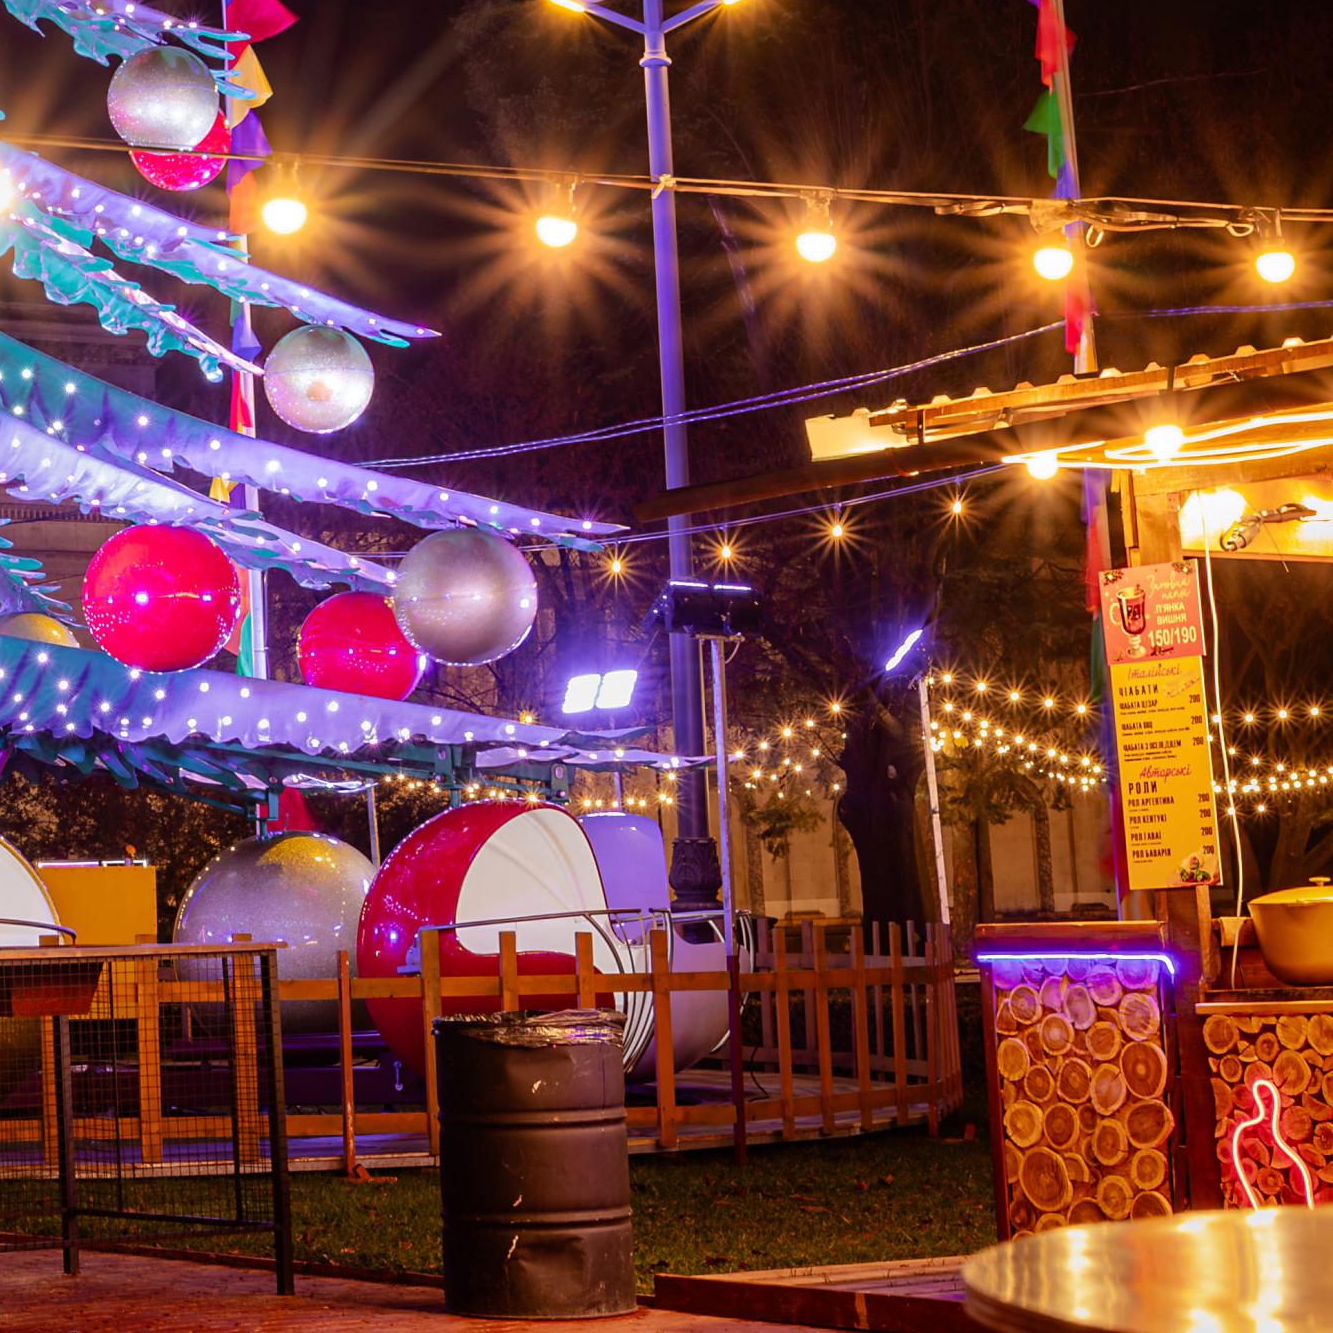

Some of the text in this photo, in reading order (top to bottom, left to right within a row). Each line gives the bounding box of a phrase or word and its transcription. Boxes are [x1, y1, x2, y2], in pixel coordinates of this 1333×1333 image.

[1157, 613, 1187, 625] ВИШНЯ
[1148, 626, 1197, 647] 150/190
[1119, 684, 1158, 697] ЧІАБАТИ
[1189, 694, 1201, 704] 200
[1191, 715, 1202, 725] 200
[1193, 736, 1204, 746] 200
[1140, 764, 1192, 783] Авторські
[1128, 781, 1157, 795] РОЛИ
[1128, 799, 1140, 807] РОЛ
[1198, 793, 1210, 803] 200
[1129, 815, 1141, 825] РОЛ
[1199, 809, 1211, 818] 200
[1131, 832, 1143, 841] РОЛ
[1200, 827, 1213, 836] 200
[1132, 850, 1145, 859] РОЛ
[1203, 845, 1215, 855] 200
